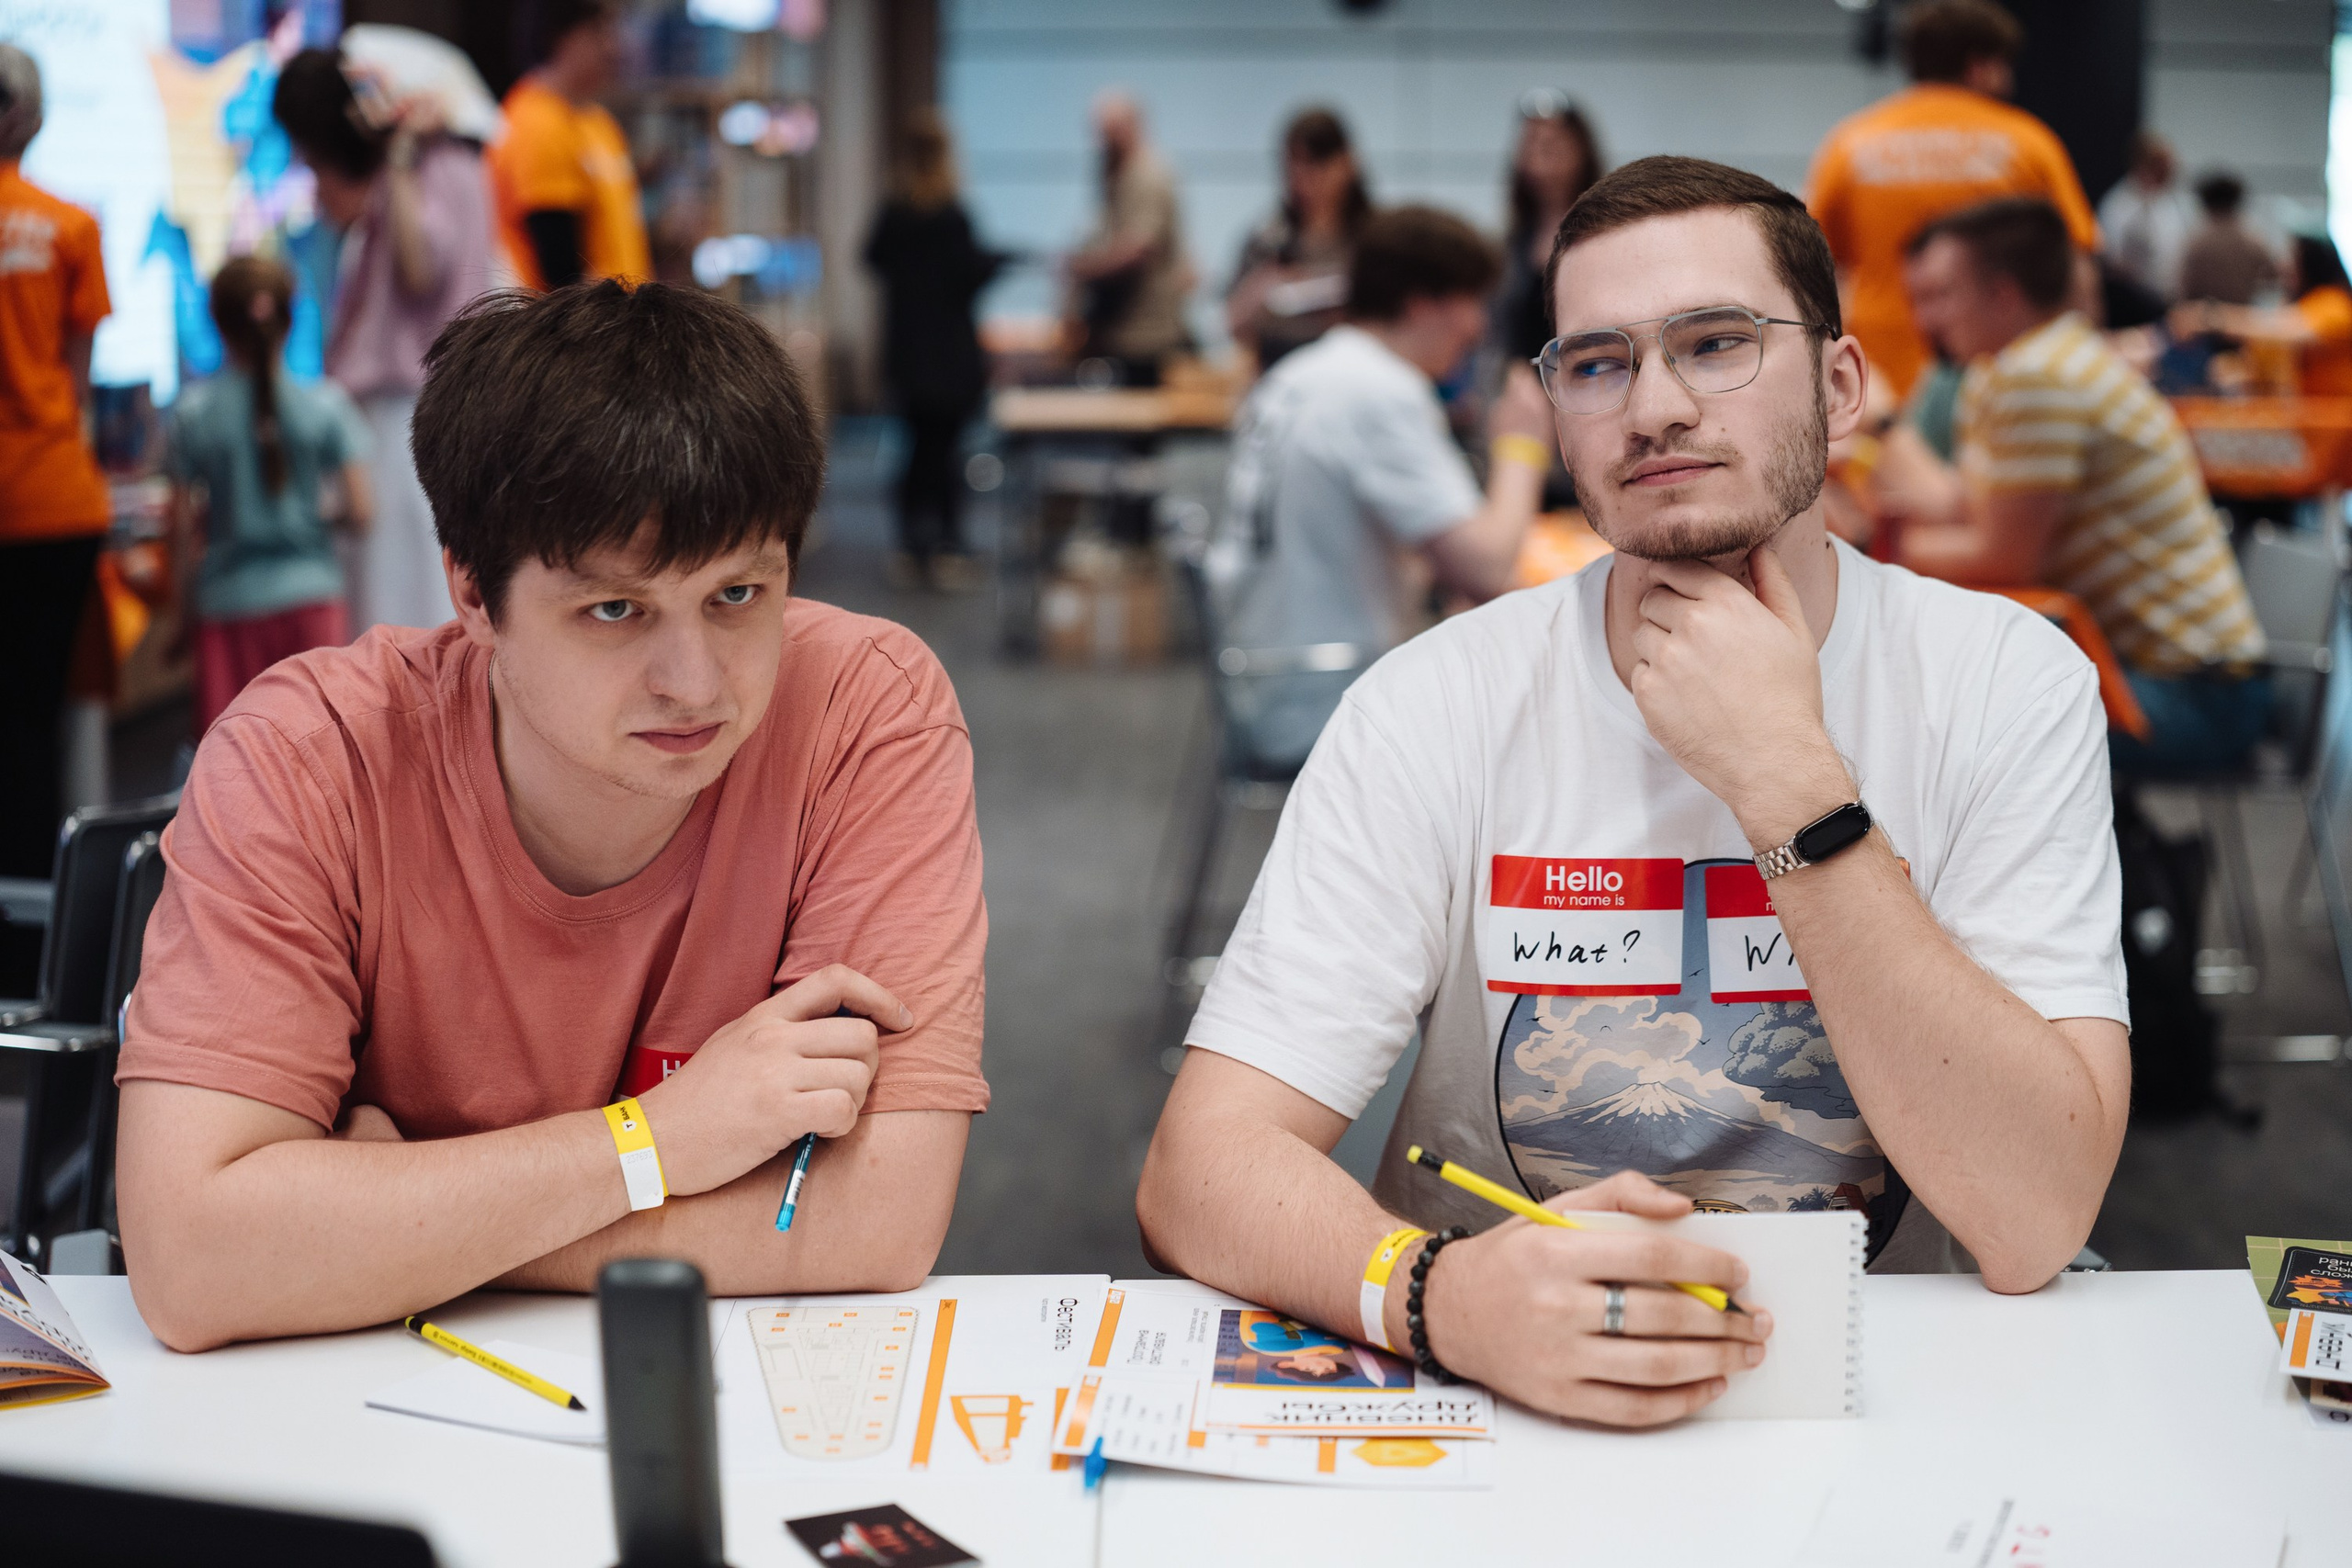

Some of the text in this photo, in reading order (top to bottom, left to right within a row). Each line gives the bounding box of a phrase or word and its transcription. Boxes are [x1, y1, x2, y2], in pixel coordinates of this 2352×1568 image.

[1545, 865, 1623, 892] Hello
[1544, 894, 1625, 908] my name is
[1745, 932, 1794, 971] W
[2319, 1257, 2352, 1267] ран
[2327, 1264, 2352, 1274] бы
[1055, 1297, 1080, 1350] Фестиваль
